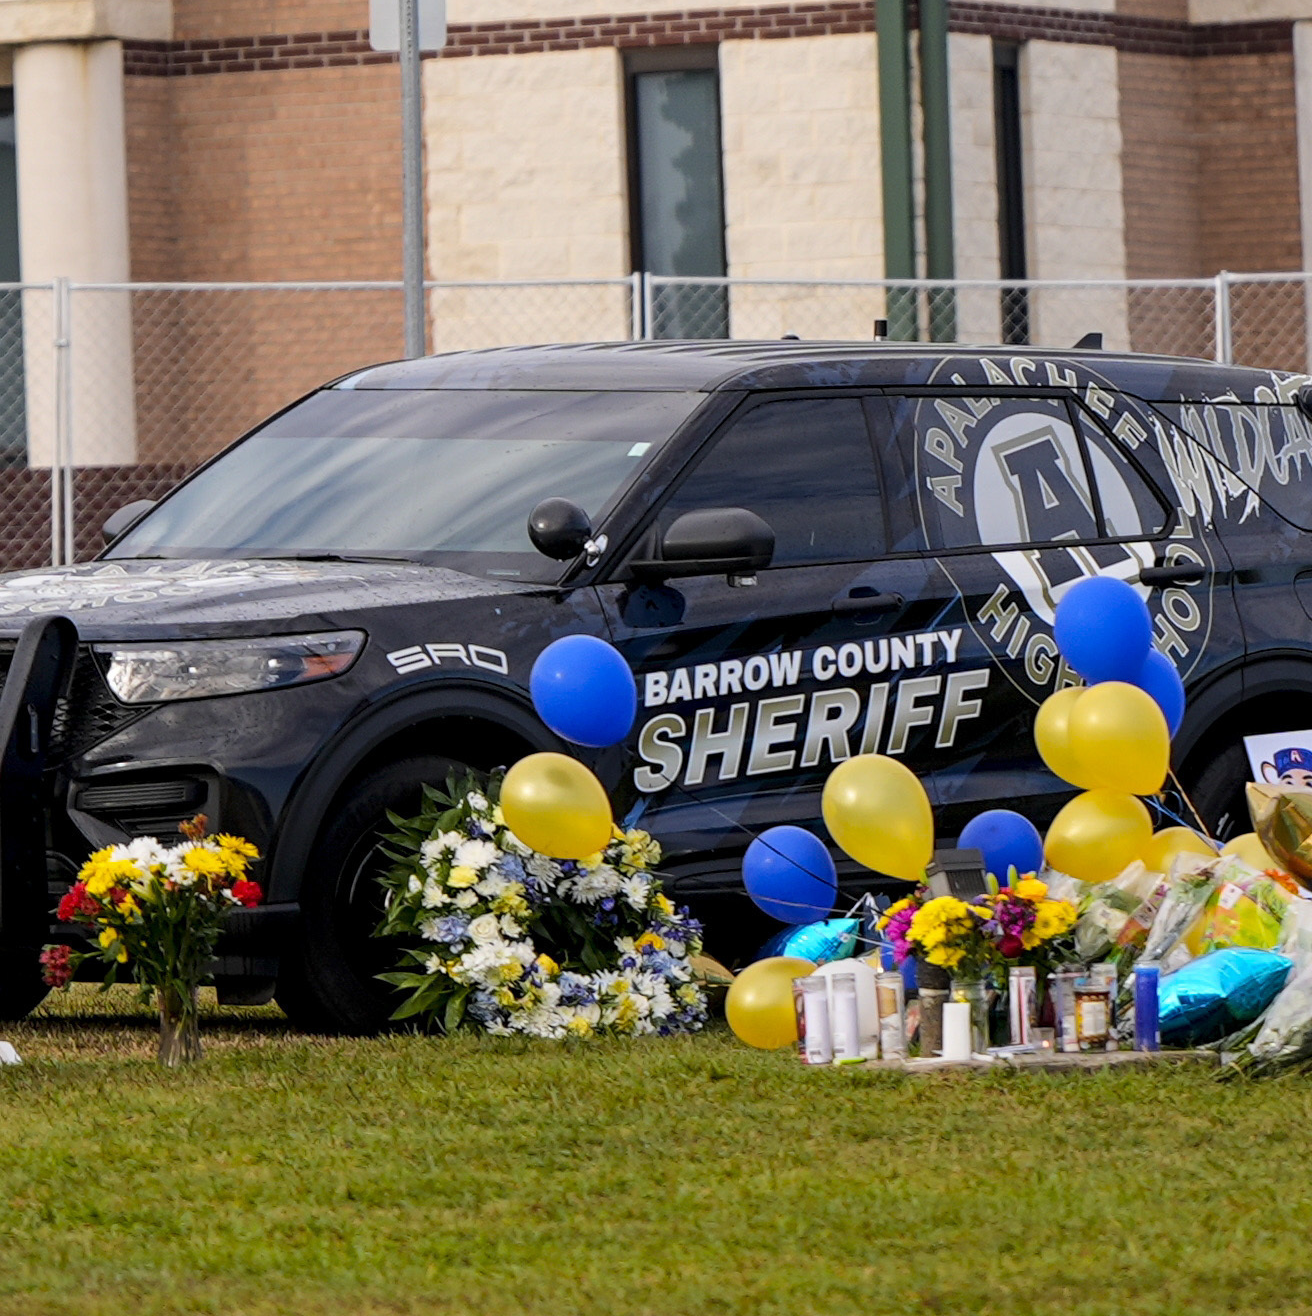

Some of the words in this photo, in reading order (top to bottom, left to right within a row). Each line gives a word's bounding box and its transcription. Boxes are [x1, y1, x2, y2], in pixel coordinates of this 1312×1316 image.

[386, 643, 508, 675] SRO
[644, 650, 803, 708] BARROW
[812, 628, 964, 681] COUNTY
[633, 668, 991, 794] SHERIFF
